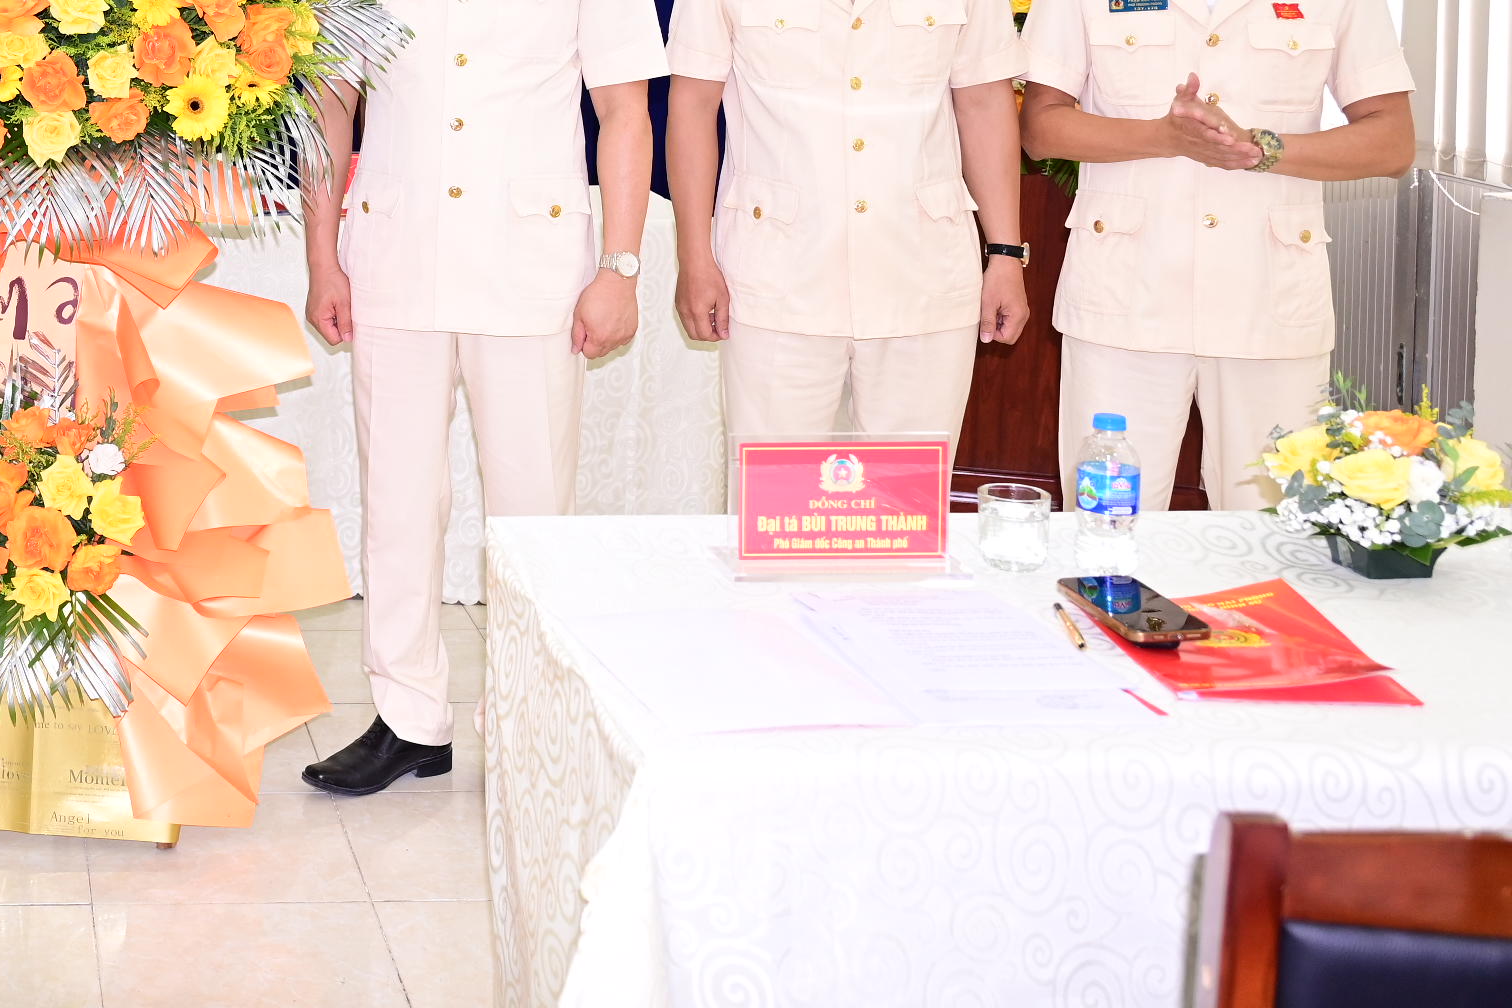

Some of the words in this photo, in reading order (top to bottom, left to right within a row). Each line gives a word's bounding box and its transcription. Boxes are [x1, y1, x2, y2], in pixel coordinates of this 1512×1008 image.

[808, 496, 848, 509] ĐỒNG
[757, 515, 781, 535] Đại
[783, 515, 798, 532] tá
[801, 512, 826, 532] BÙI
[829, 515, 877, 532] TRUNG
[880, 512, 928, 532] THÀNH
[773, 537, 790, 549] Phó
[791, 537, 813, 549] Giám
[814, 536, 830, 549] đốc
[831, 537, 853, 550] Công
[854, 539, 865, 549] an
[892, 536, 909, 550] phố
